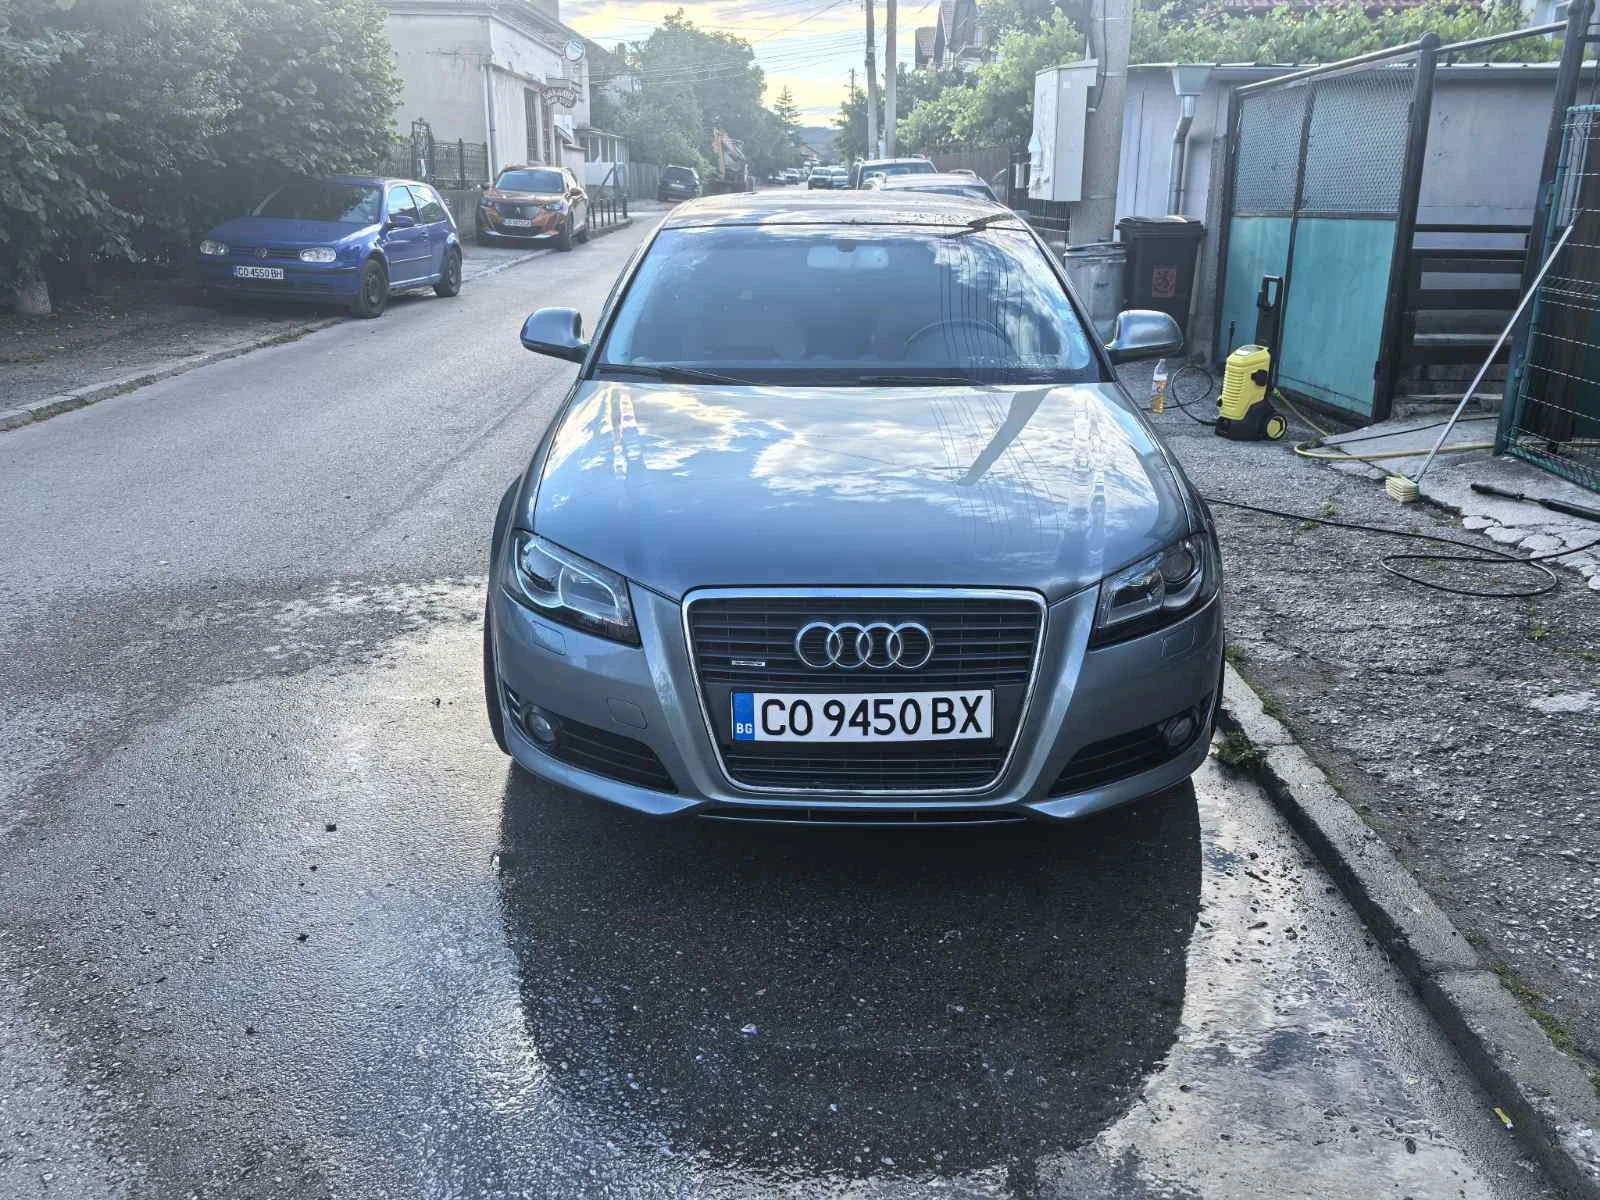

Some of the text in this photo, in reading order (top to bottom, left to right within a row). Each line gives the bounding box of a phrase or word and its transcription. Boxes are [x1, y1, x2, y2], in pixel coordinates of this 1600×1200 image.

[761, 695, 984, 736] CO 9450 BX
[736, 723, 753, 735] BG
